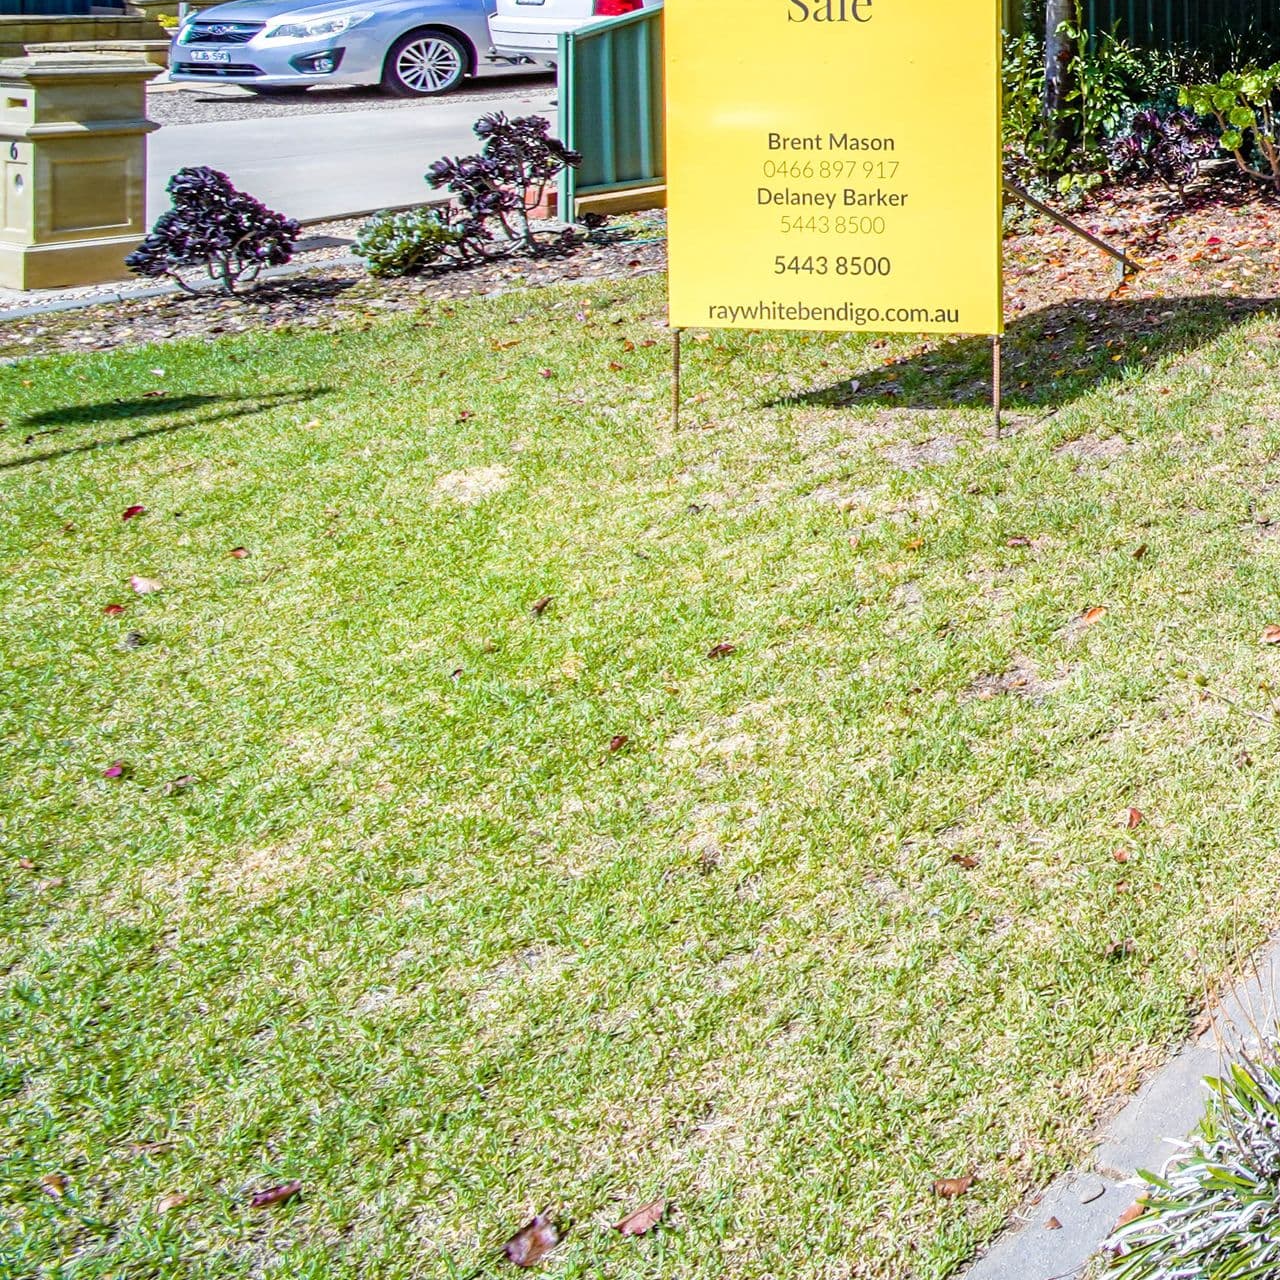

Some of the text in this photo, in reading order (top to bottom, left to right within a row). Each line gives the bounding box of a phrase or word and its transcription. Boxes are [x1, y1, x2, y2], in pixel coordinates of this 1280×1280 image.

[10, 141, 19, 161] 6
[767, 132, 895, 152] Brent Mason
[762, 159, 900, 179] 0466 897 917
[757, 187, 909, 210] Delaney Barker
[780, 215, 886, 235] 5443 8500
[773, 255, 892, 277] 5443 8500
[708, 299, 960, 327] raywhitebendigo.com.au
